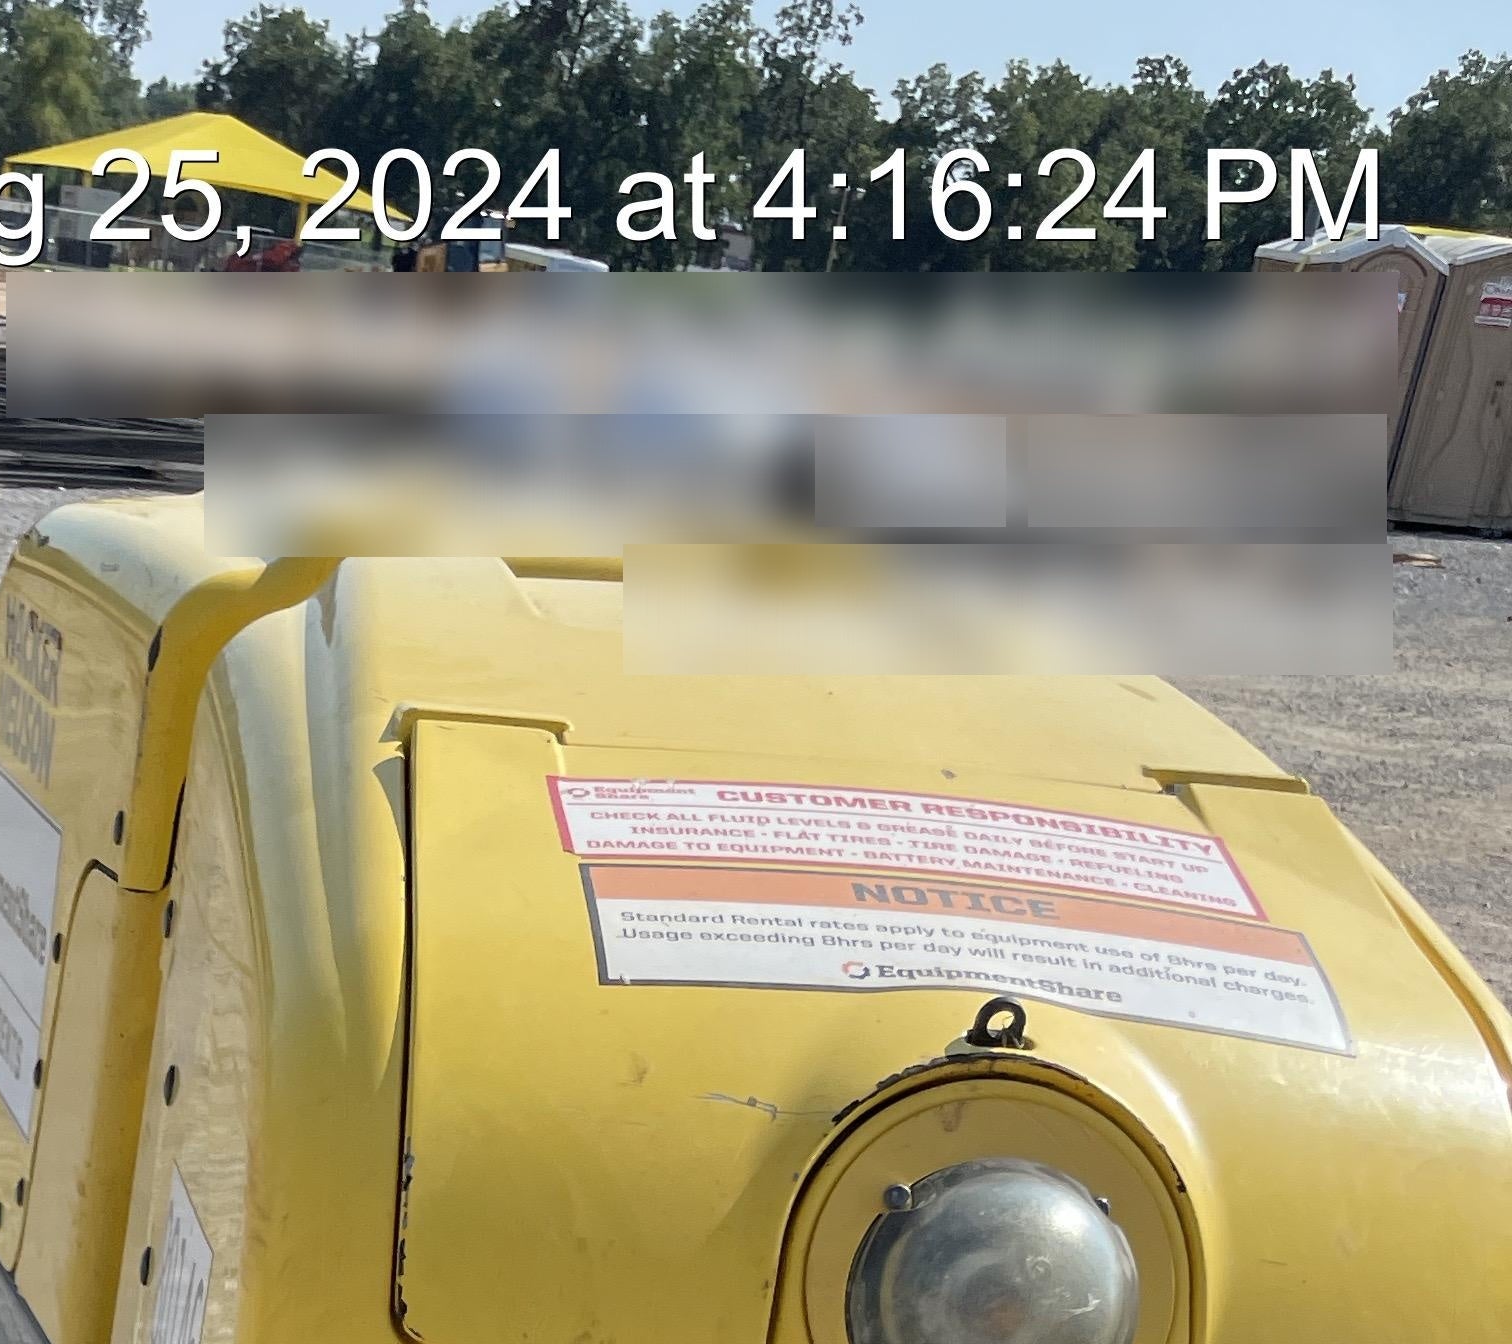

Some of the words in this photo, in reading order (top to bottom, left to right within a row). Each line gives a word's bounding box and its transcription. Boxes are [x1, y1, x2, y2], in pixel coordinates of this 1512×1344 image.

[593, 785, 696, 796] Equipment
[590, 811, 659, 821] CHECK
[667, 812, 702, 823] ALL
[708, 814, 771, 826] FLUID
[776, 817, 852, 830] LEVELS
[877, 823, 958, 838] GREASE
[964, 831, 1025, 846] DAILY
[1029, 838, 1106, 857] BEFORE
[1113, 851, 1175, 870] START
[1180, 862, 1209, 874] UP
[716, 789, 912, 813] CUSTOMER
[923, 802, 1213, 856] RESPONSIBILITY
[586, 840, 678, 851] DAMAGE
[684, 842, 711, 852] TO
[717, 843, 845, 858] EQUIPMENT
[863, 850, 956, 867] BATTERY
[962, 859, 1117, 887] MAINTENANCE
[1133, 882, 1237, 907] CLEANING
[629, 826, 756, 839] INSURANCE
[773, 830, 821, 842] FLAT
[828, 834, 892, 846] TIRES
[910, 840, 958, 853] TIRE
[964, 845, 1052, 864] DAMAGE
[1069, 858, 1184, 884] REFUELING
[851, 882, 1060, 919] NOTICE
[620, 911, 725, 925] Standard
[732, 914, 803, 928] Rental
[809, 919, 870, 932] rates
[876, 923, 935, 938] apply
[941, 927, 965, 938] to
[971, 929, 1089, 954] equipment
[1094, 944, 1134, 959] use
[1140, 950, 1161, 963] of
[1223, 964, 1257, 980] per
[1263, 970, 1307, 988] day.
[622, 928, 692, 942] Usage
[700, 931, 815, 948] exceeding
[821, 934, 874, 949] 8hrs
[880, 939, 916, 953] per
[923, 941, 962, 957] day
[968, 945, 1006, 960] will
[1012, 950, 1077, 967] result
[1082, 957, 1103, 971] in
[1108, 963, 1217, 988] additional
[875, 964, 1124, 1003] EquipmentShare
